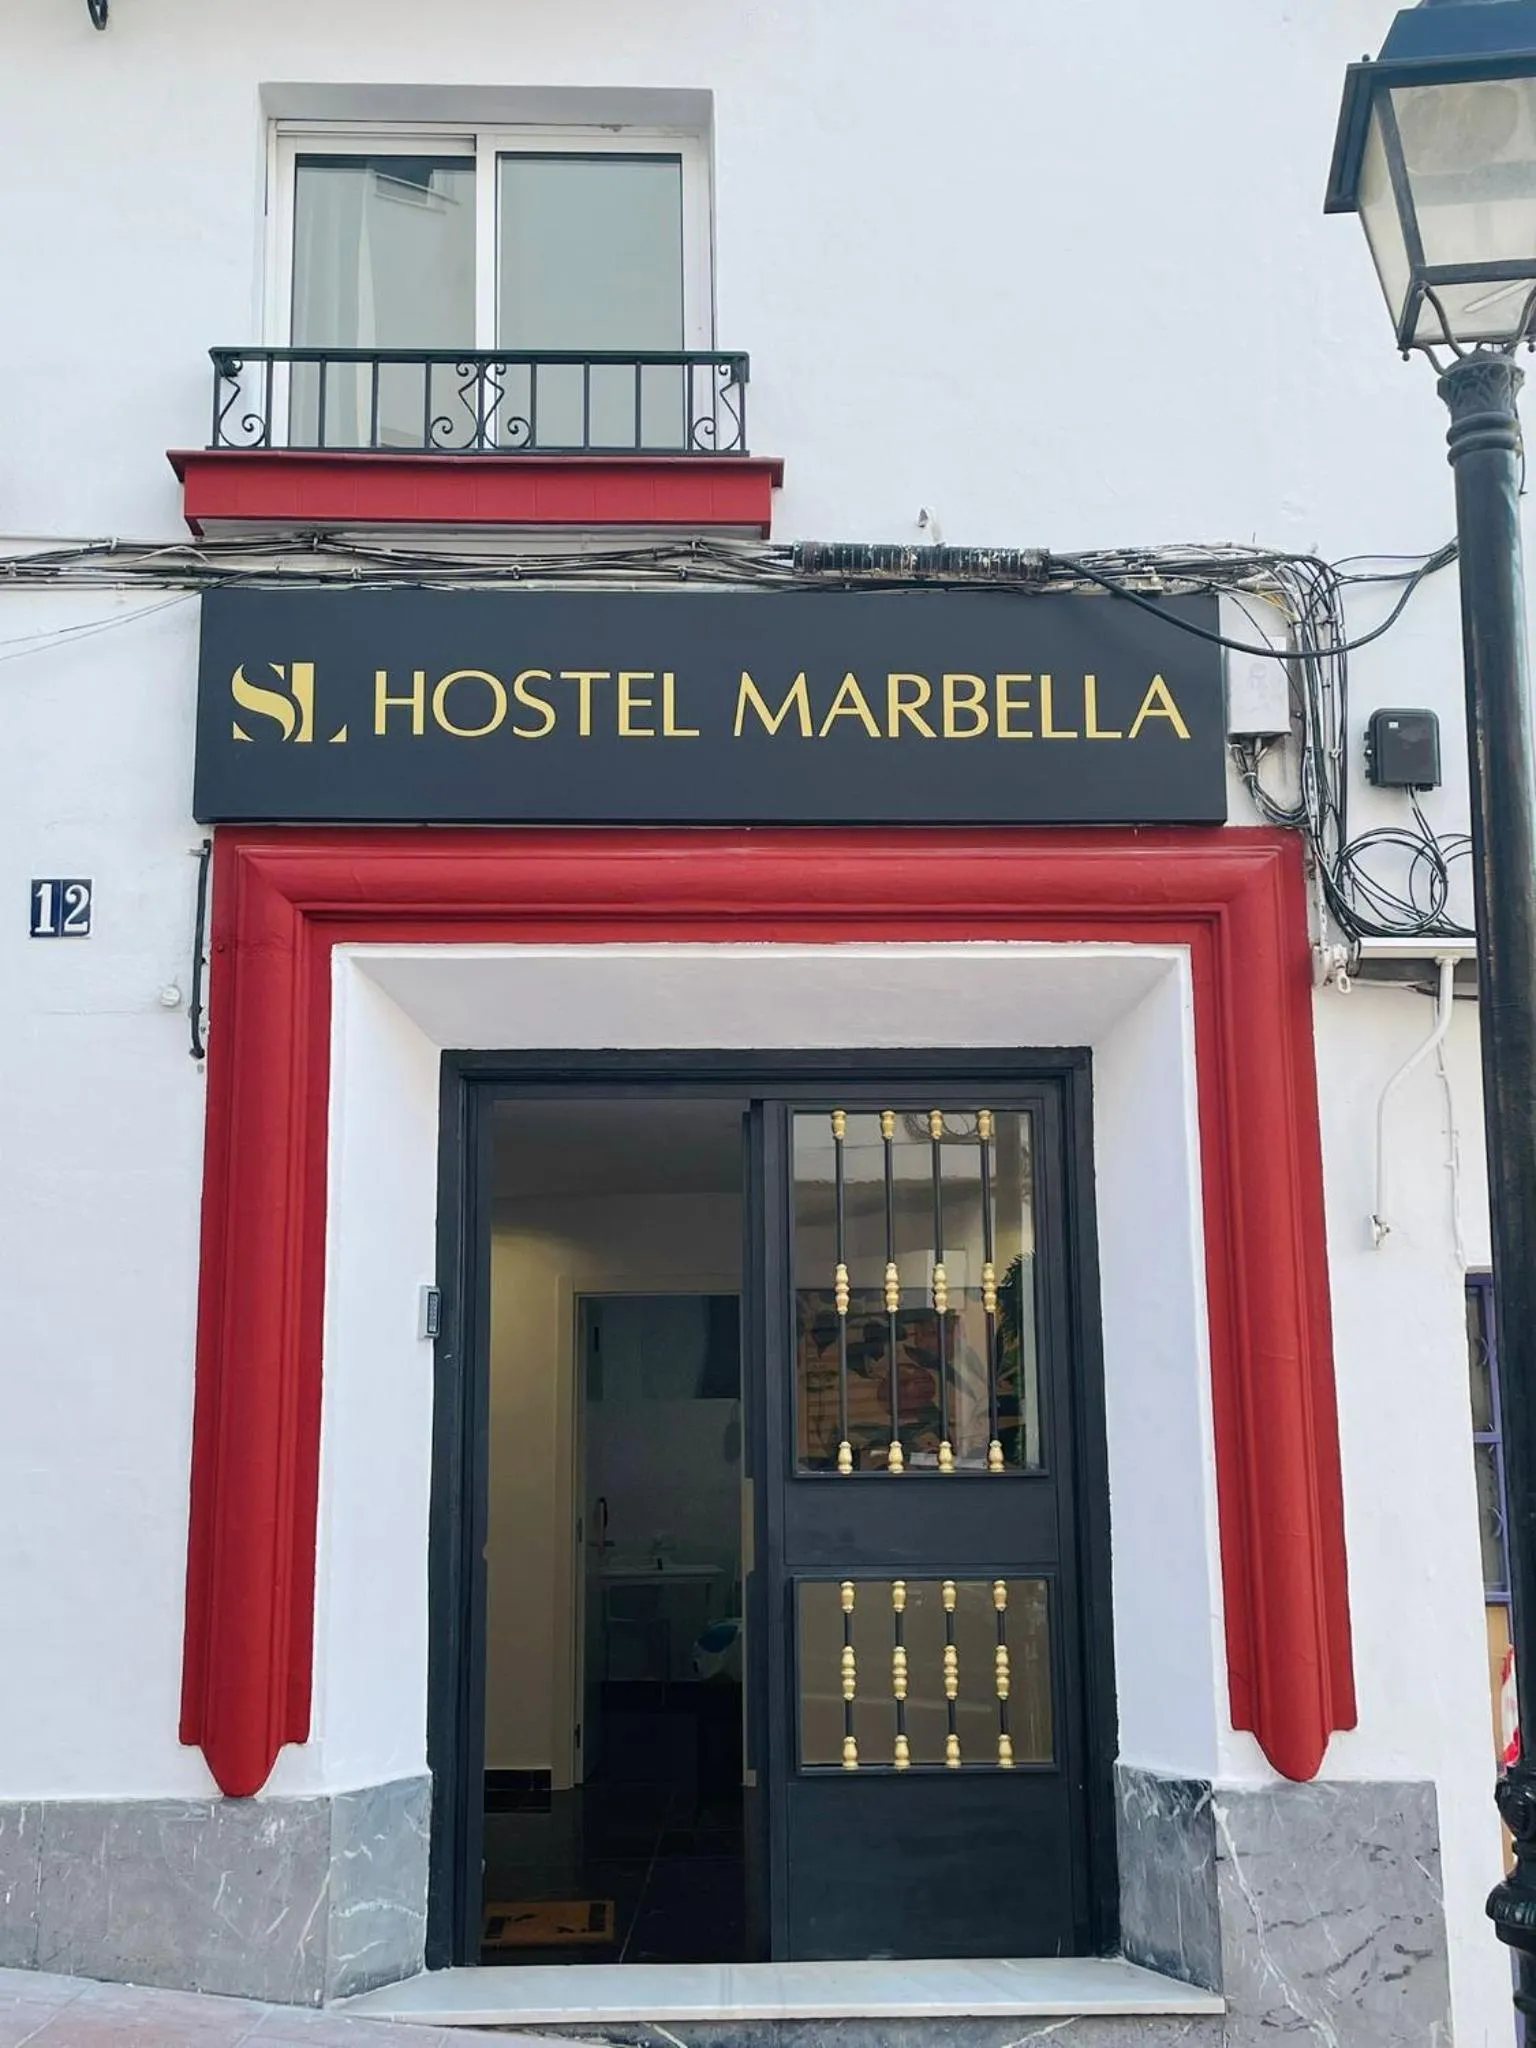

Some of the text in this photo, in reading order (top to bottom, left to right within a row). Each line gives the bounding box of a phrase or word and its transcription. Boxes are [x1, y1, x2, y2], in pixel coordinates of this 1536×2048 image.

[374, 670, 700, 739] HOSTEL
[733, 672, 1191, 740] MARBELLA
[34, 882, 90, 933] 12
